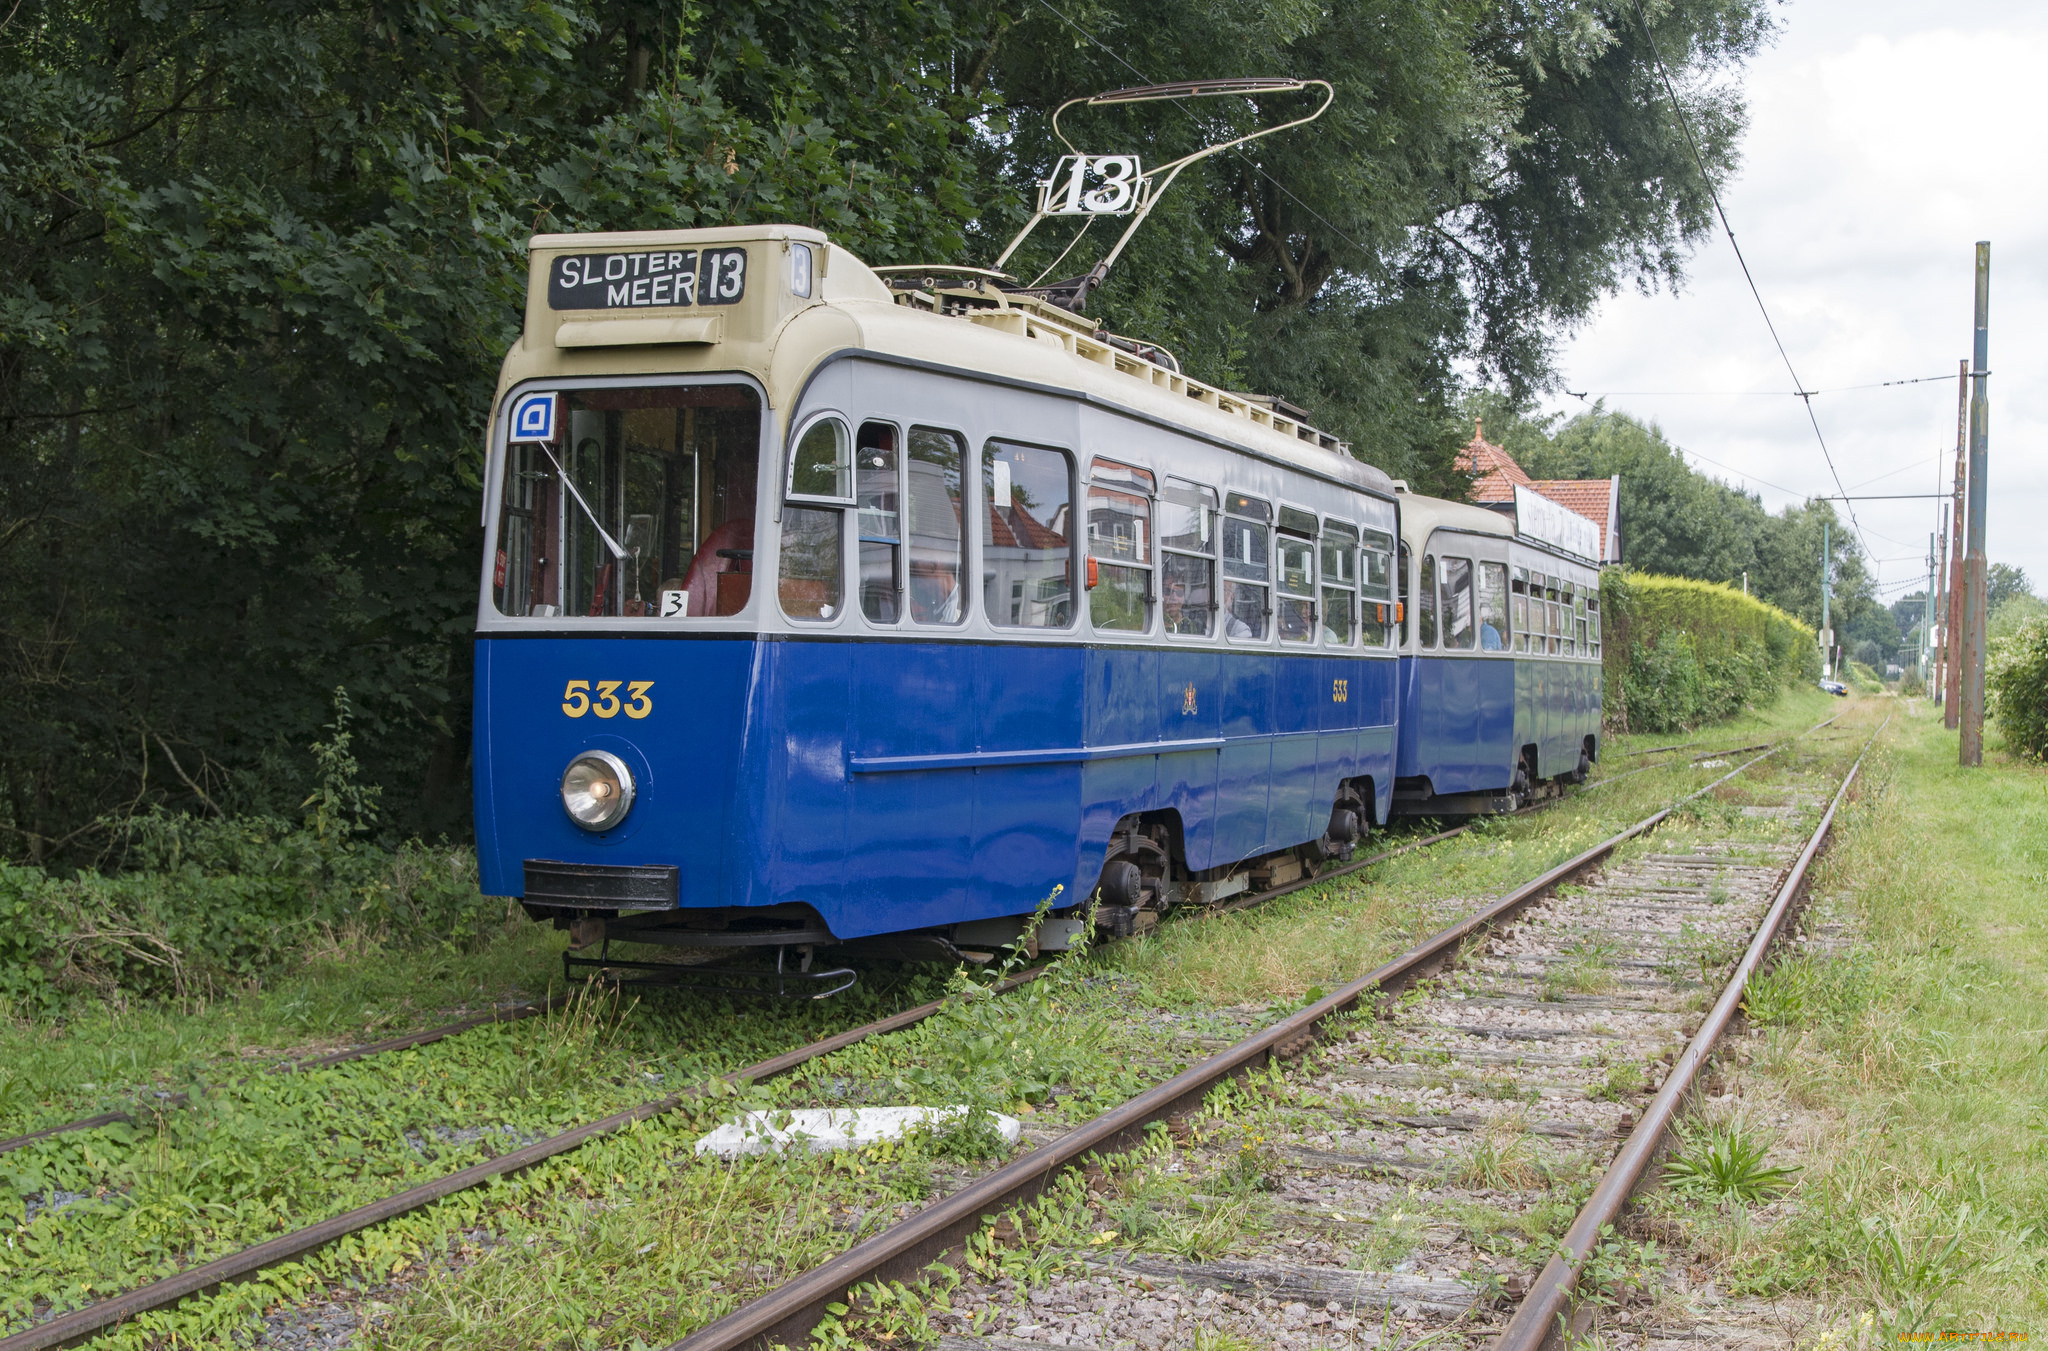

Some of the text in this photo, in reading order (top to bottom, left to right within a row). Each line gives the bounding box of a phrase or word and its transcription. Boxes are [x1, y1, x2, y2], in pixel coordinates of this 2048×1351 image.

[1060, 155, 1133, 213] 13
[607, 271, 696, 307] MEER
[709, 252, 745, 299] 13
[663, 592, 683, 617] 3
[561, 679, 655, 719] 533
[1332, 679, 1348, 703] 533
